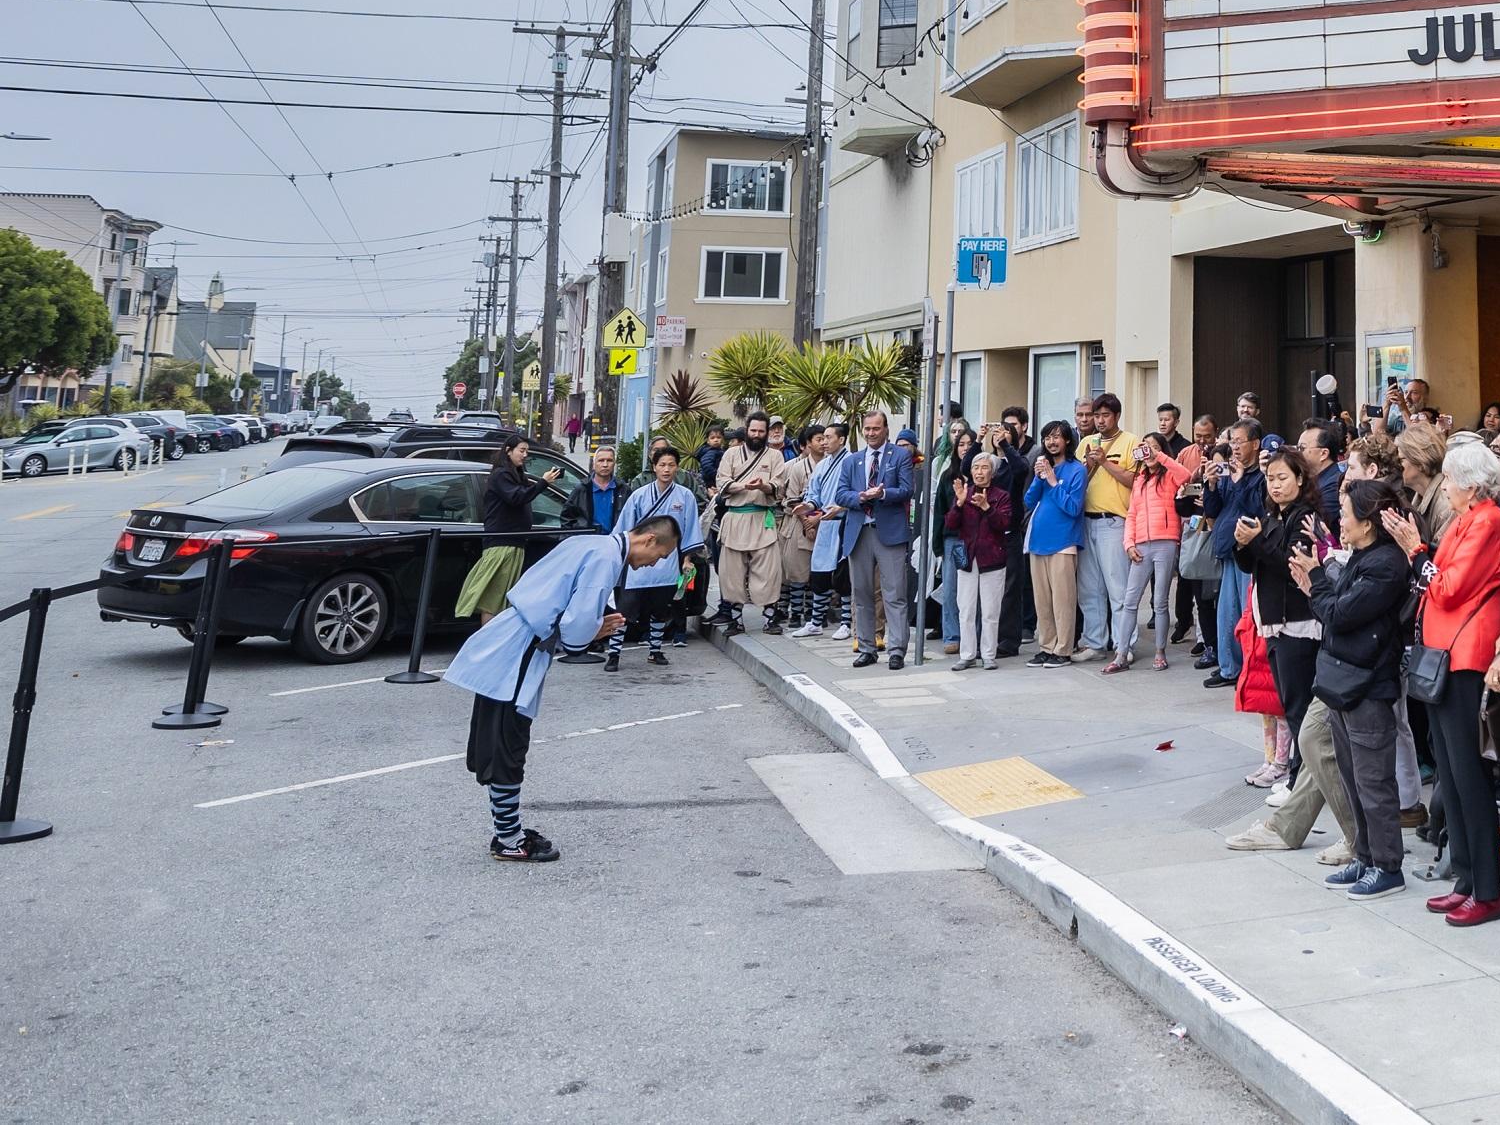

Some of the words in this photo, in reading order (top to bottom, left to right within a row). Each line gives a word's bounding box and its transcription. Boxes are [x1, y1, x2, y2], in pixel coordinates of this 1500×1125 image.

[961, 240, 979, 251] PAY
[980, 240, 1006, 251] HERE
[657, 316, 666, 325] NO
[1143, 936, 1203, 974] PASSENGER
[1190, 973, 1241, 1003] LOADING
